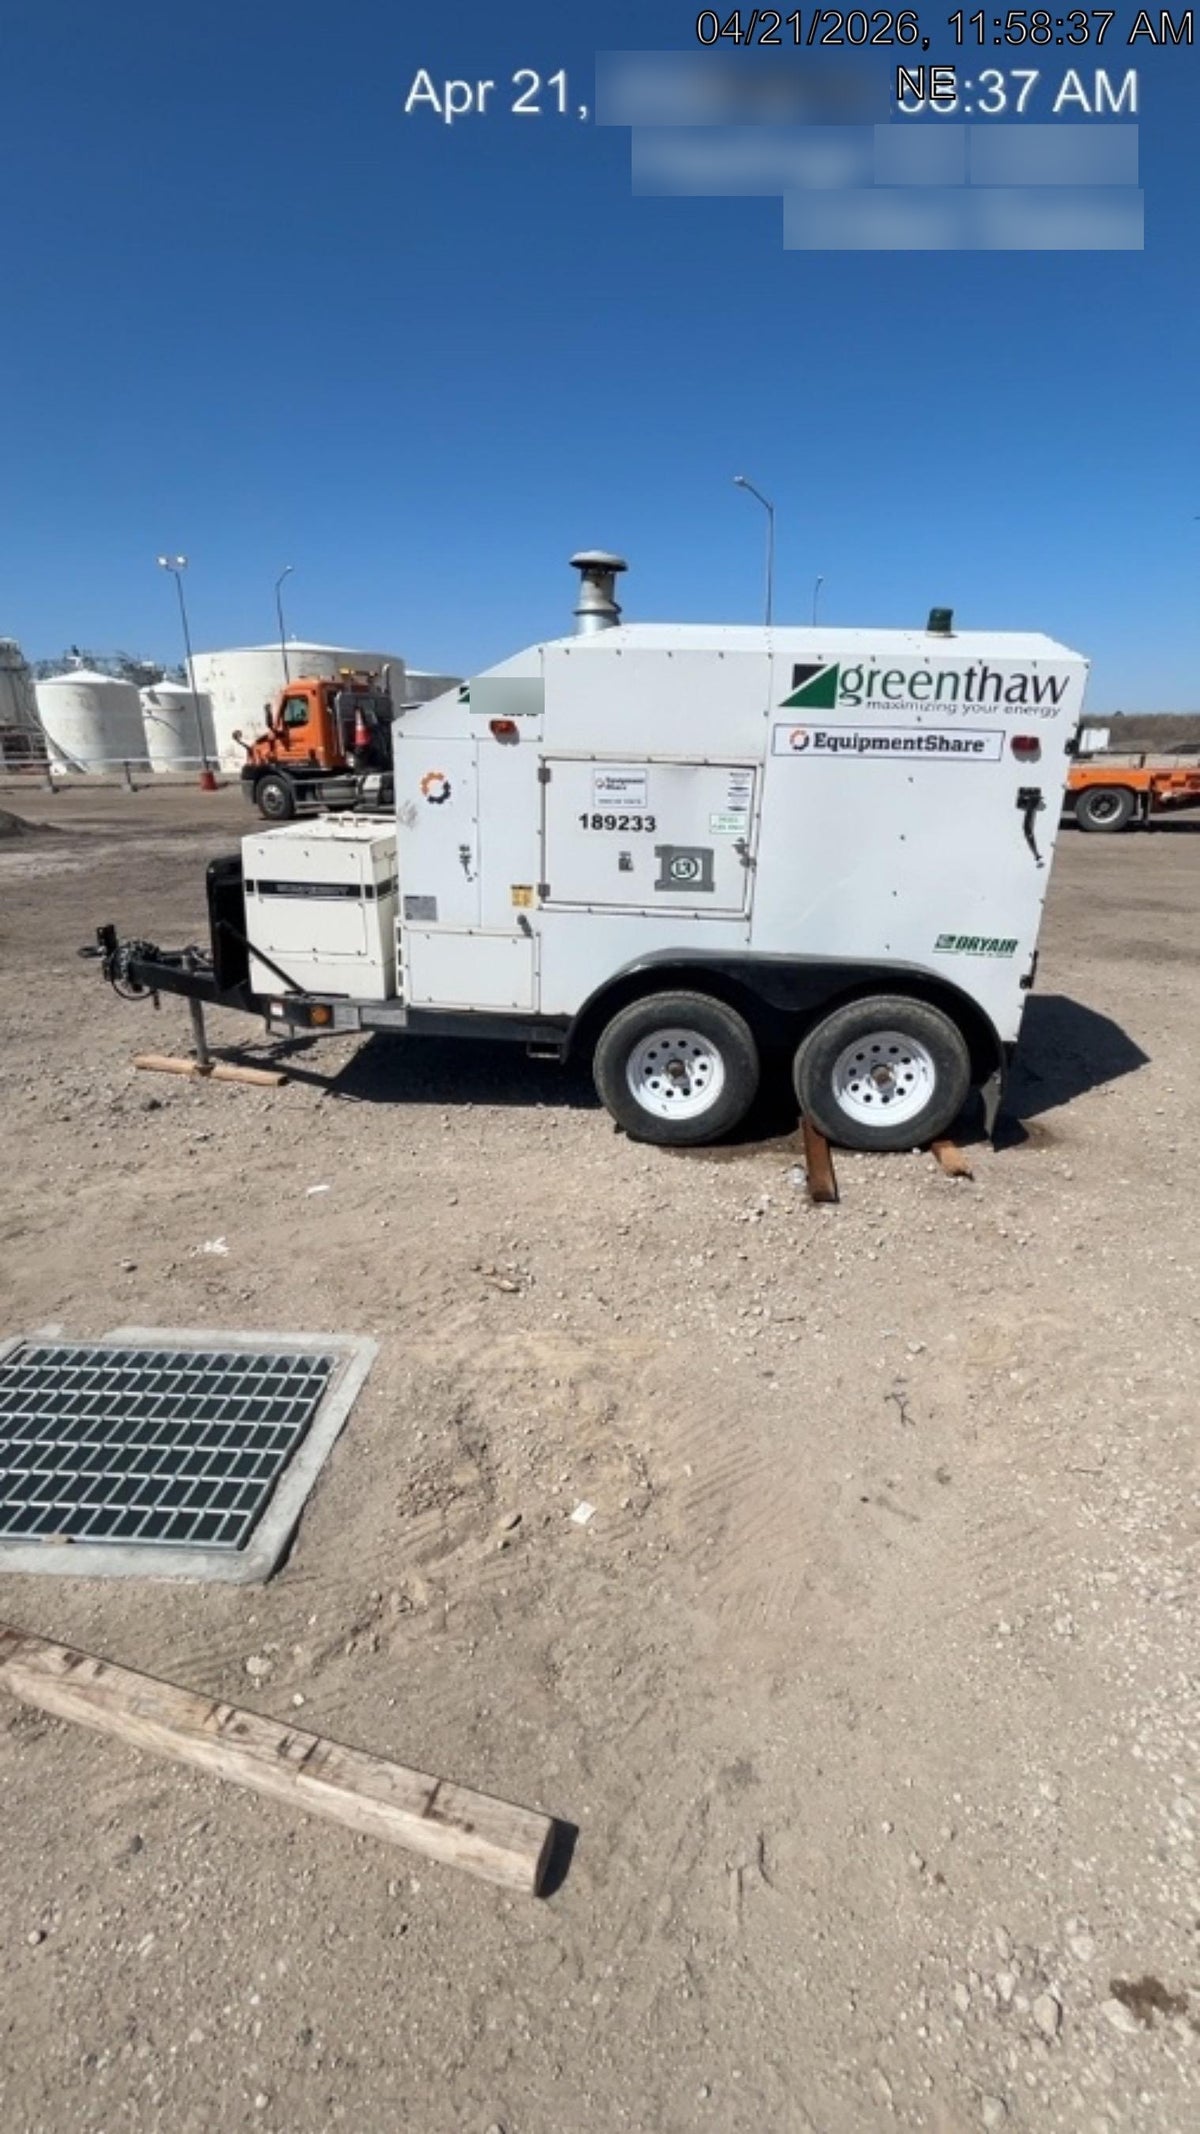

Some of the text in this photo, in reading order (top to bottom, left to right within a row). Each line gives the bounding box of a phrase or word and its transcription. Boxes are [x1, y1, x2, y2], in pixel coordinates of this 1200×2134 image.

[839, 662, 1070, 707] greenthaw
[865, 698, 1061, 719] maximizing your energy
[812, 731, 985, 753] EquipmentShare
[578, 813, 657, 832] 189233
